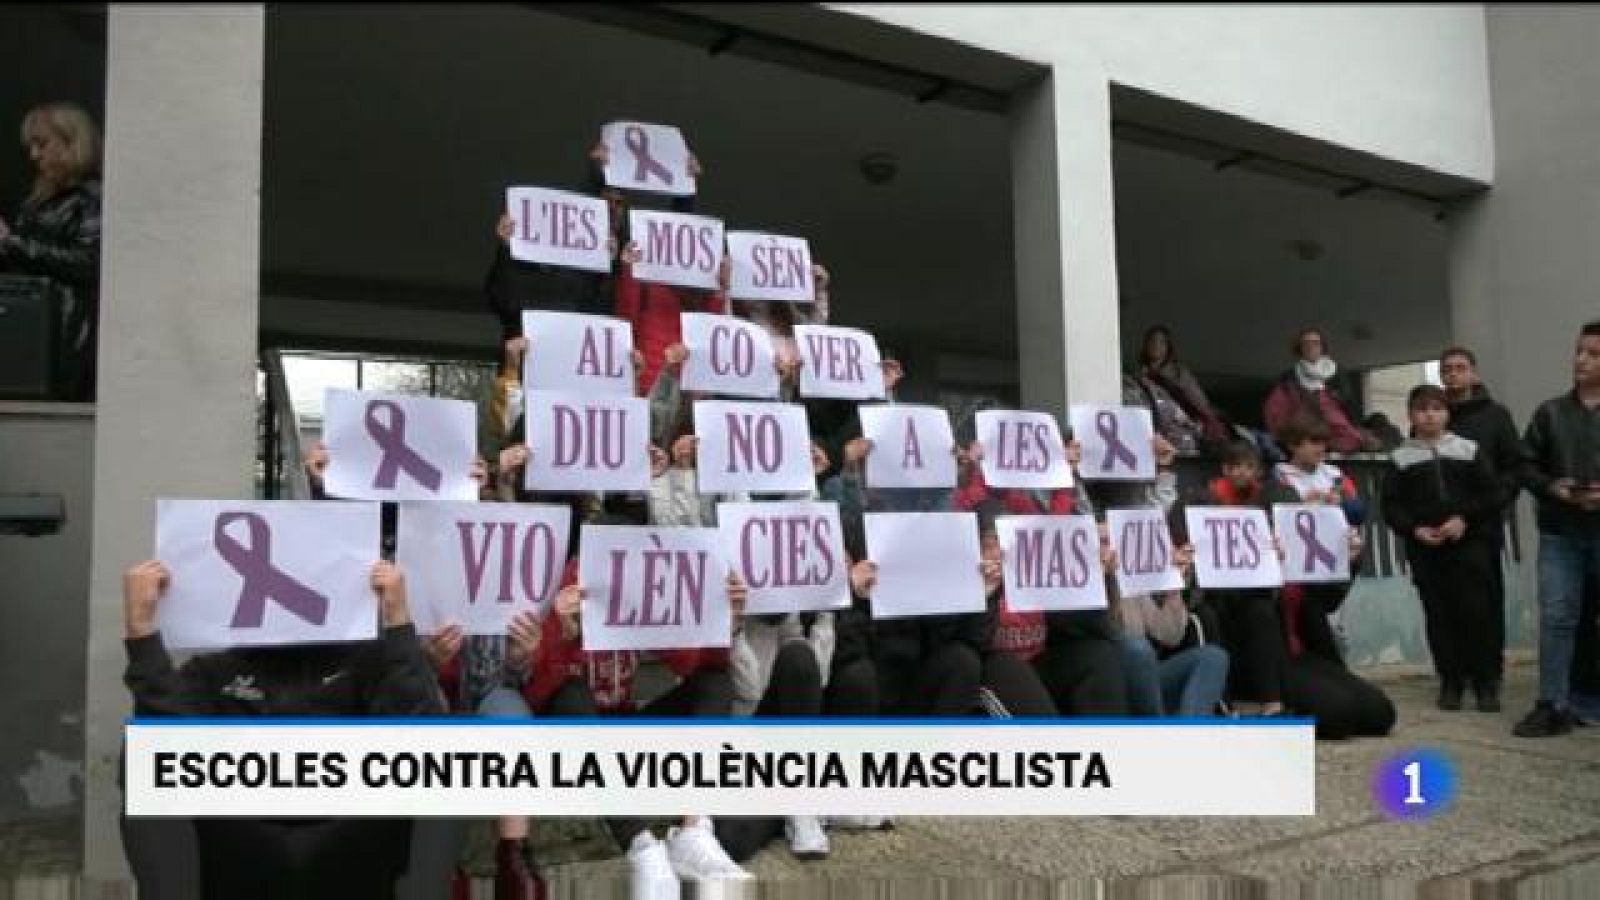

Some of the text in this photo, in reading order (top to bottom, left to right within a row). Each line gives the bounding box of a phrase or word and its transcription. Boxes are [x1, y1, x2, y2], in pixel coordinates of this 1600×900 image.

[519, 198, 807, 290] L'IES MOS SÈN
[577, 325, 865, 383] AL CO VER
[552, 406, 1053, 474] DIU NO A LES
[456, 515, 1261, 627] VIO LÈN CIES MAS CLIS TES
